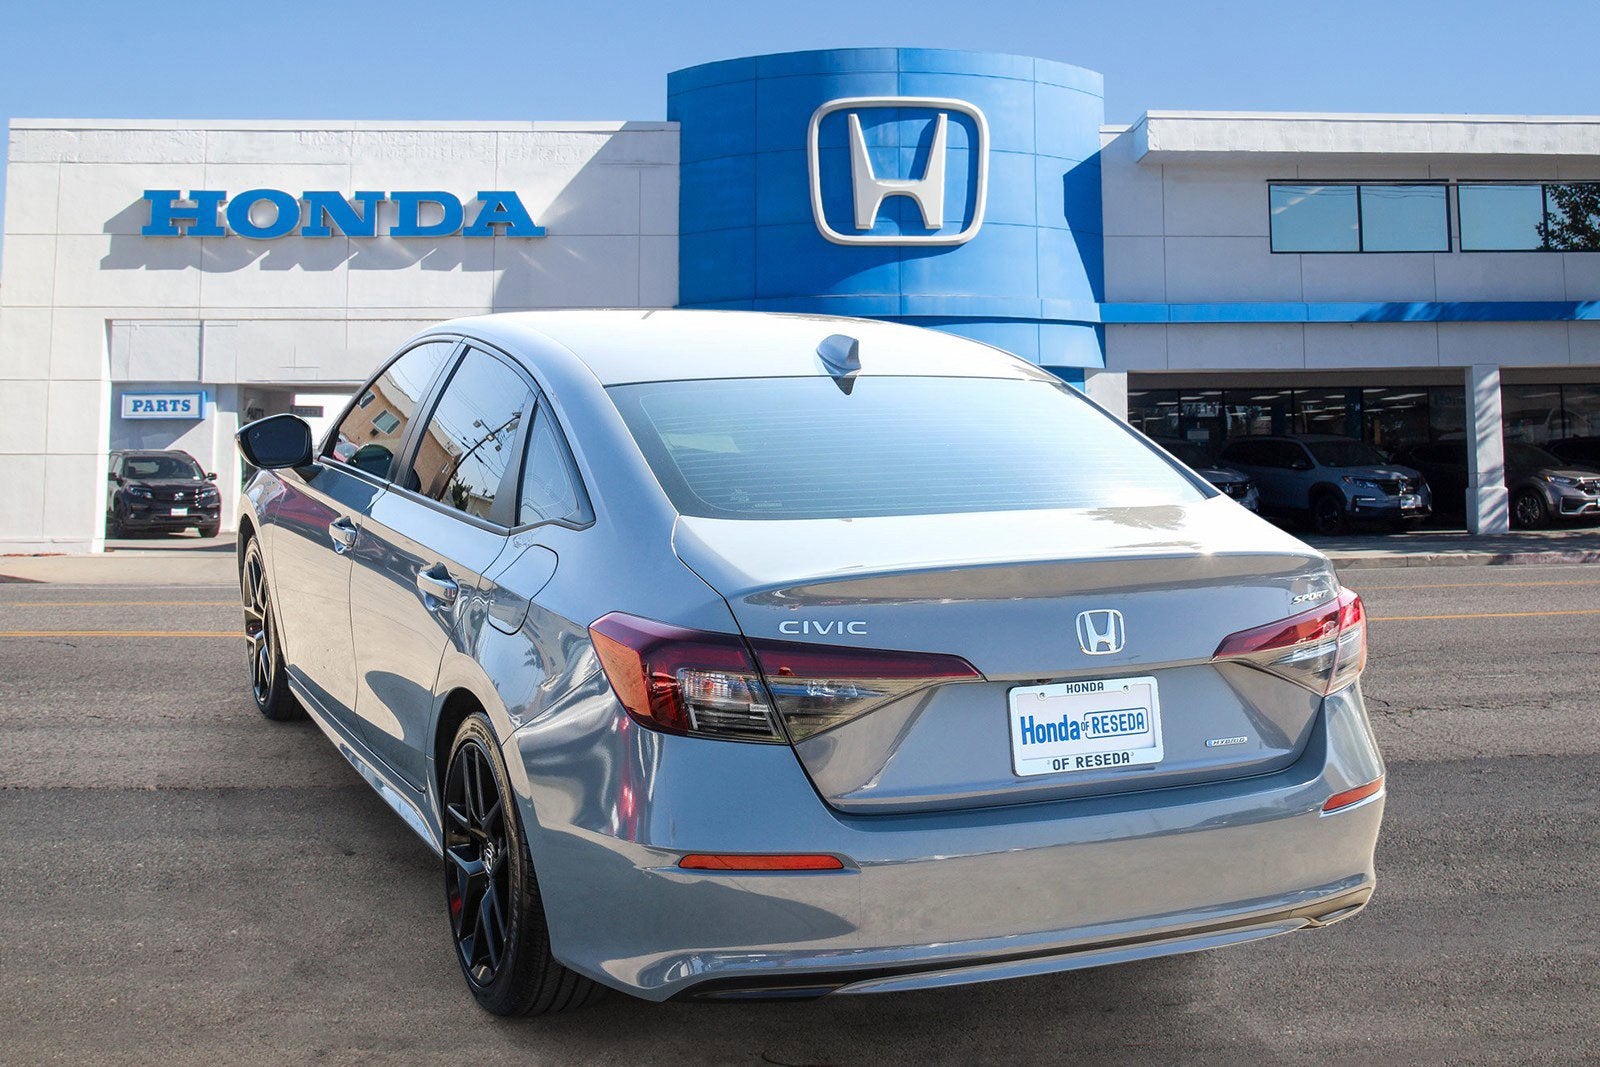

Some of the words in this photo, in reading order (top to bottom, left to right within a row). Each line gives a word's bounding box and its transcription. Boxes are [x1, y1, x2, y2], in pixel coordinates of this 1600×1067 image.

[141, 188, 548, 240] HONDA
[131, 399, 192, 412] PARTS
[1291, 589, 1329, 605] SPORT
[778, 620, 867, 635] CIVIC
[1066, 681, 1105, 694] HONDA
[1020, 714, 1081, 745] Honda
[1081, 721, 1090, 732] OF
[1092, 712, 1145, 734] RESEDA
[1052, 757, 1070, 771] OF
[1076, 751, 1130, 769] RESEDA
